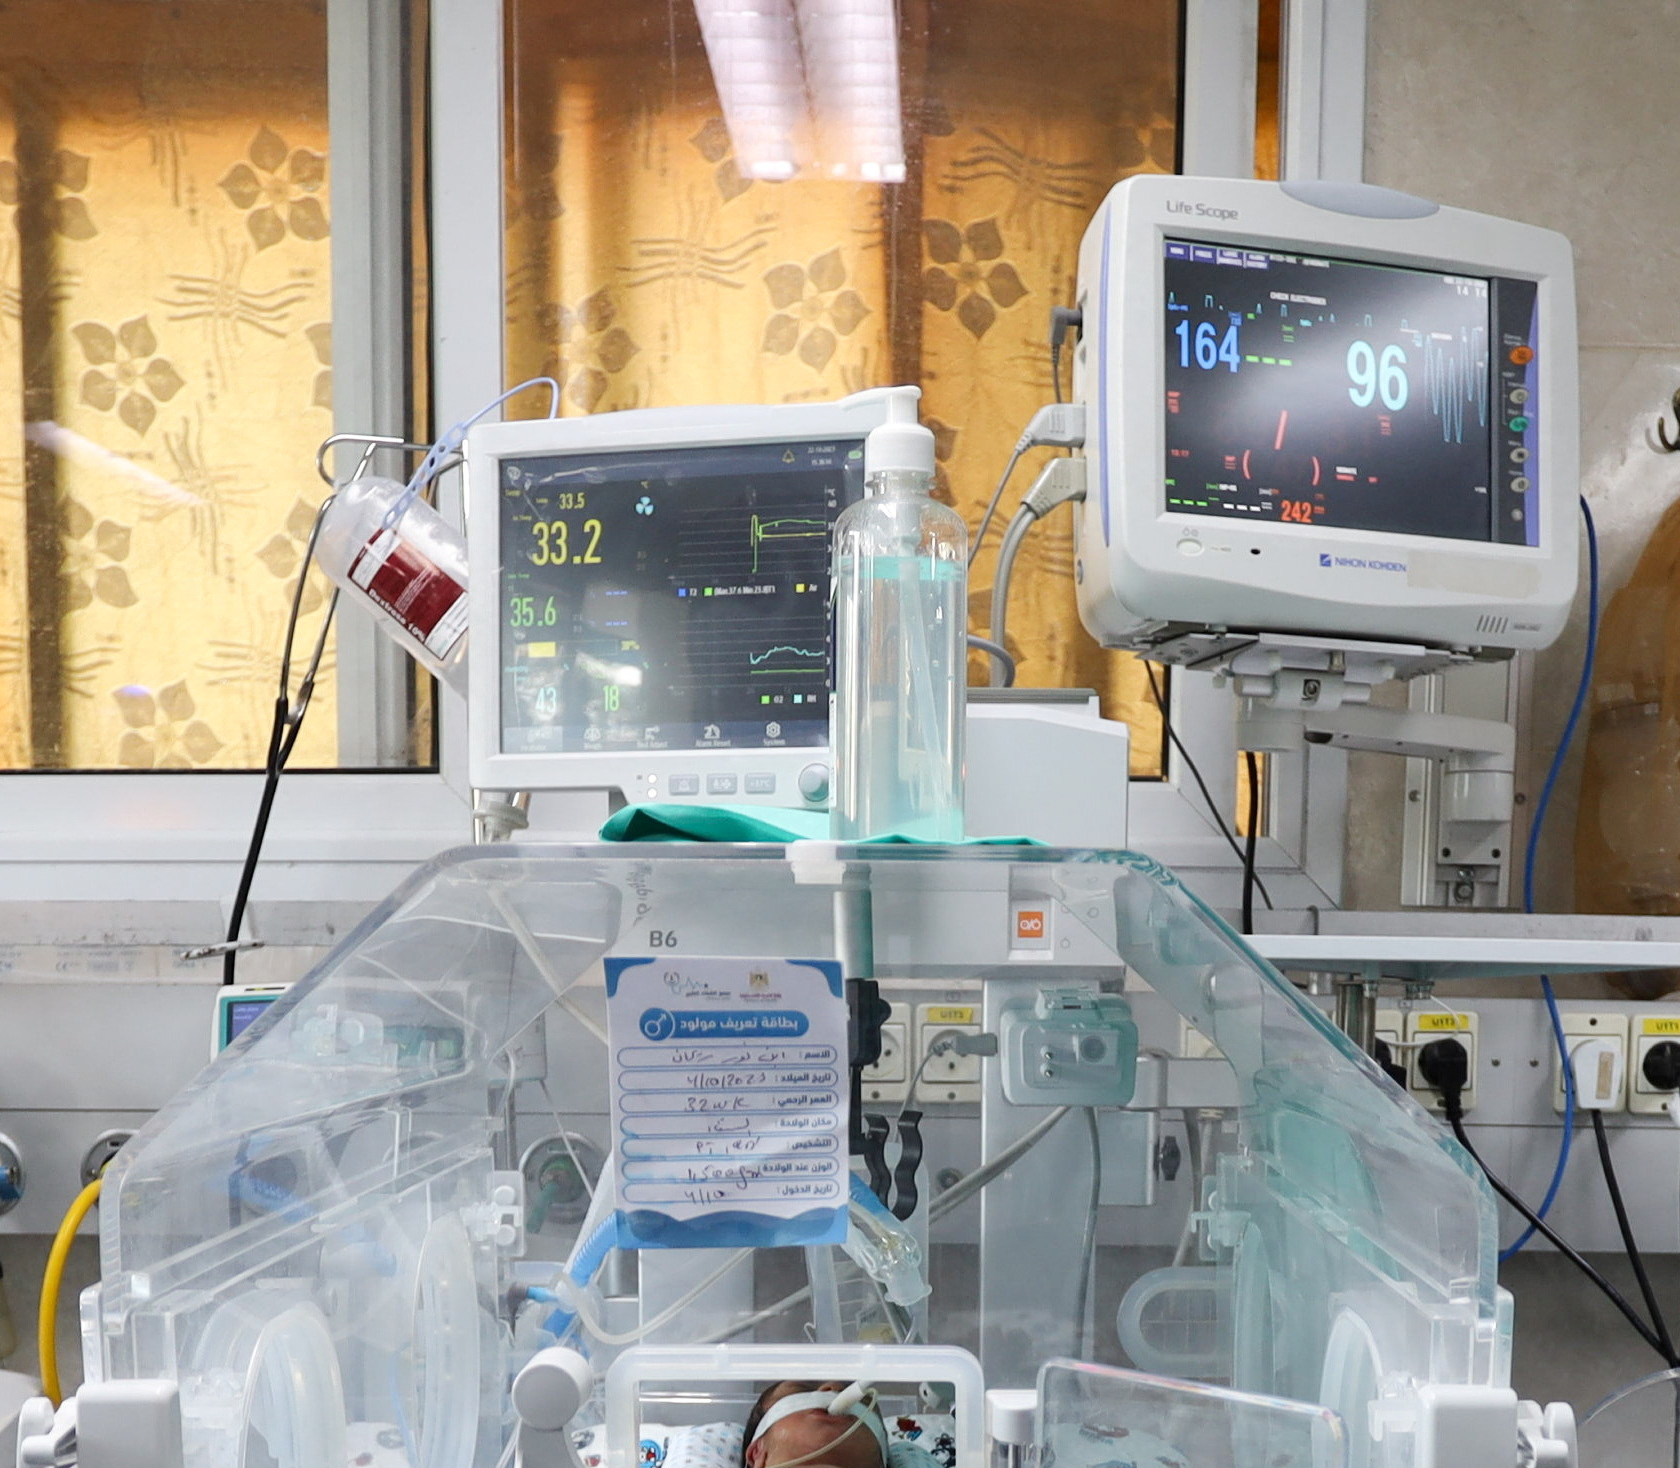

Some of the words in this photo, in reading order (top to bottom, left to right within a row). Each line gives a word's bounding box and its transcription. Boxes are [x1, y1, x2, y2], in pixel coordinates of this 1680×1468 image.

[1167, 201, 1193, 214] Life
[1196, 203, 1238, 220] Scope
[1175, 320, 1240, 373] 164
[1347, 340, 1409, 411] 96
[559, 493, 585, 509] 33.5
[1281, 500, 1312, 522] 242
[532, 519, 601, 565] 33.2
[1335, 558, 1366, 568] NIHON
[1369, 560, 1406, 572] KOHDEN
[369, 588, 407, 625] Dextrose
[510, 596, 556, 627] 35.6
[535, 687, 556, 712] 43
[603, 685, 620, 711] 18
[650, 931, 677, 947] B6
[680, 1018, 716, 1030] مولود
[720, 1018, 757, 1030] تعريف
[762, 1018, 798, 1030] بطاقة
[811, 1074, 831, 1083] تاريخ
[809, 1095, 831, 1105] العمر
[811, 1119, 831, 1127] مكان
[792, 1140, 831, 1150] التشخيص
[812, 1163, 832, 1172] الوزن
[814, 1185, 832, 1194] تاريخ
